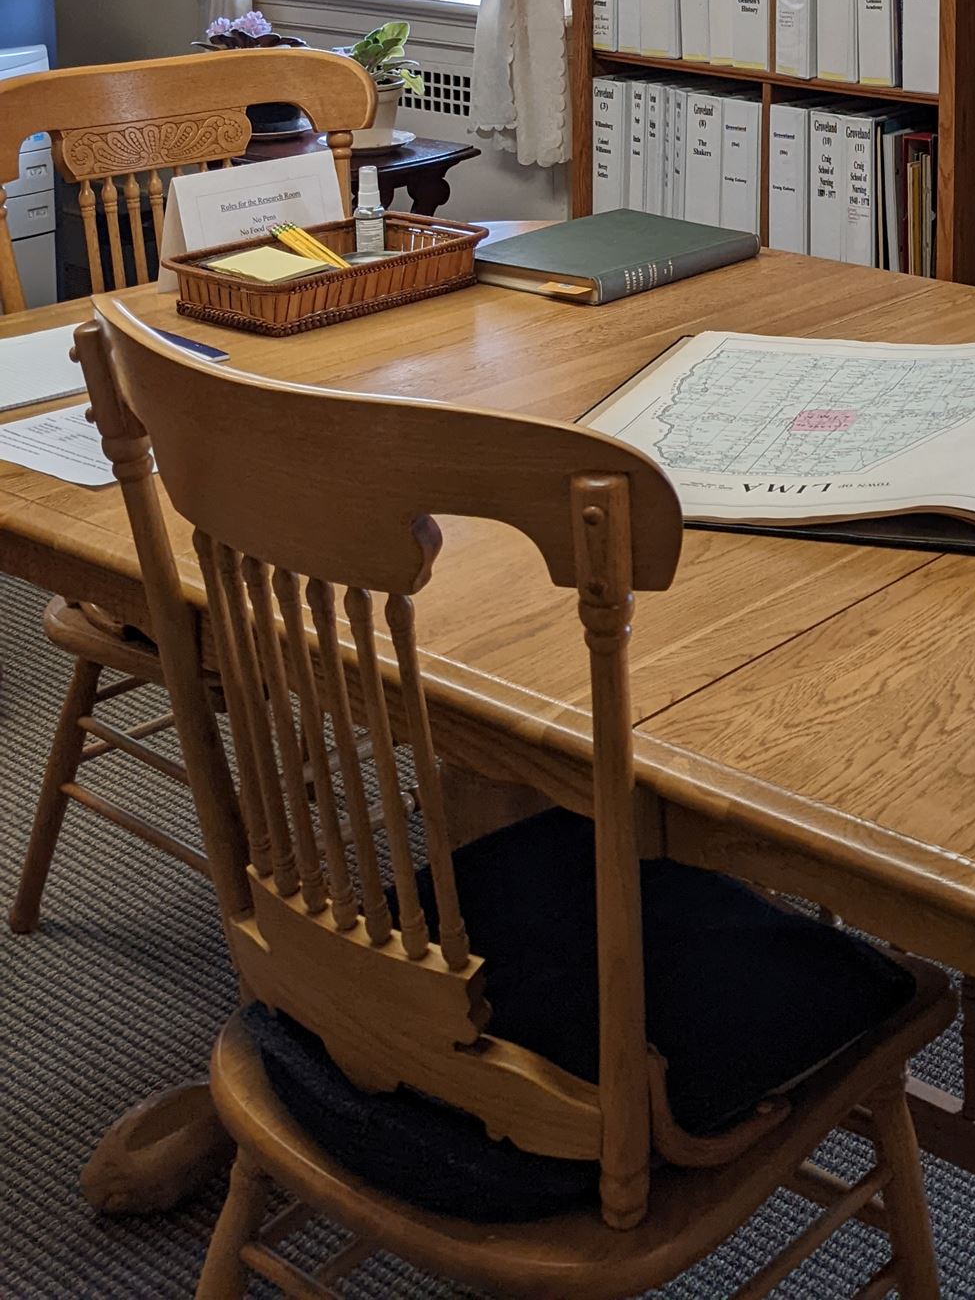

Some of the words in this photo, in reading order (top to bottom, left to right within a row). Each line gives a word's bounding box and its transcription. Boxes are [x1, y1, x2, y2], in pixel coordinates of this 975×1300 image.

[846, 127, 870, 140] Groveland
[693, 148, 711, 156] Shakers
[221, 204, 237, 212] Rules
[248, 199, 256, 207] the
[258, 194, 283, 204] Research
[284, 191, 301, 199] Room
[250, 225, 265, 234] Food
[743, 483, 832, 493] LIMA
